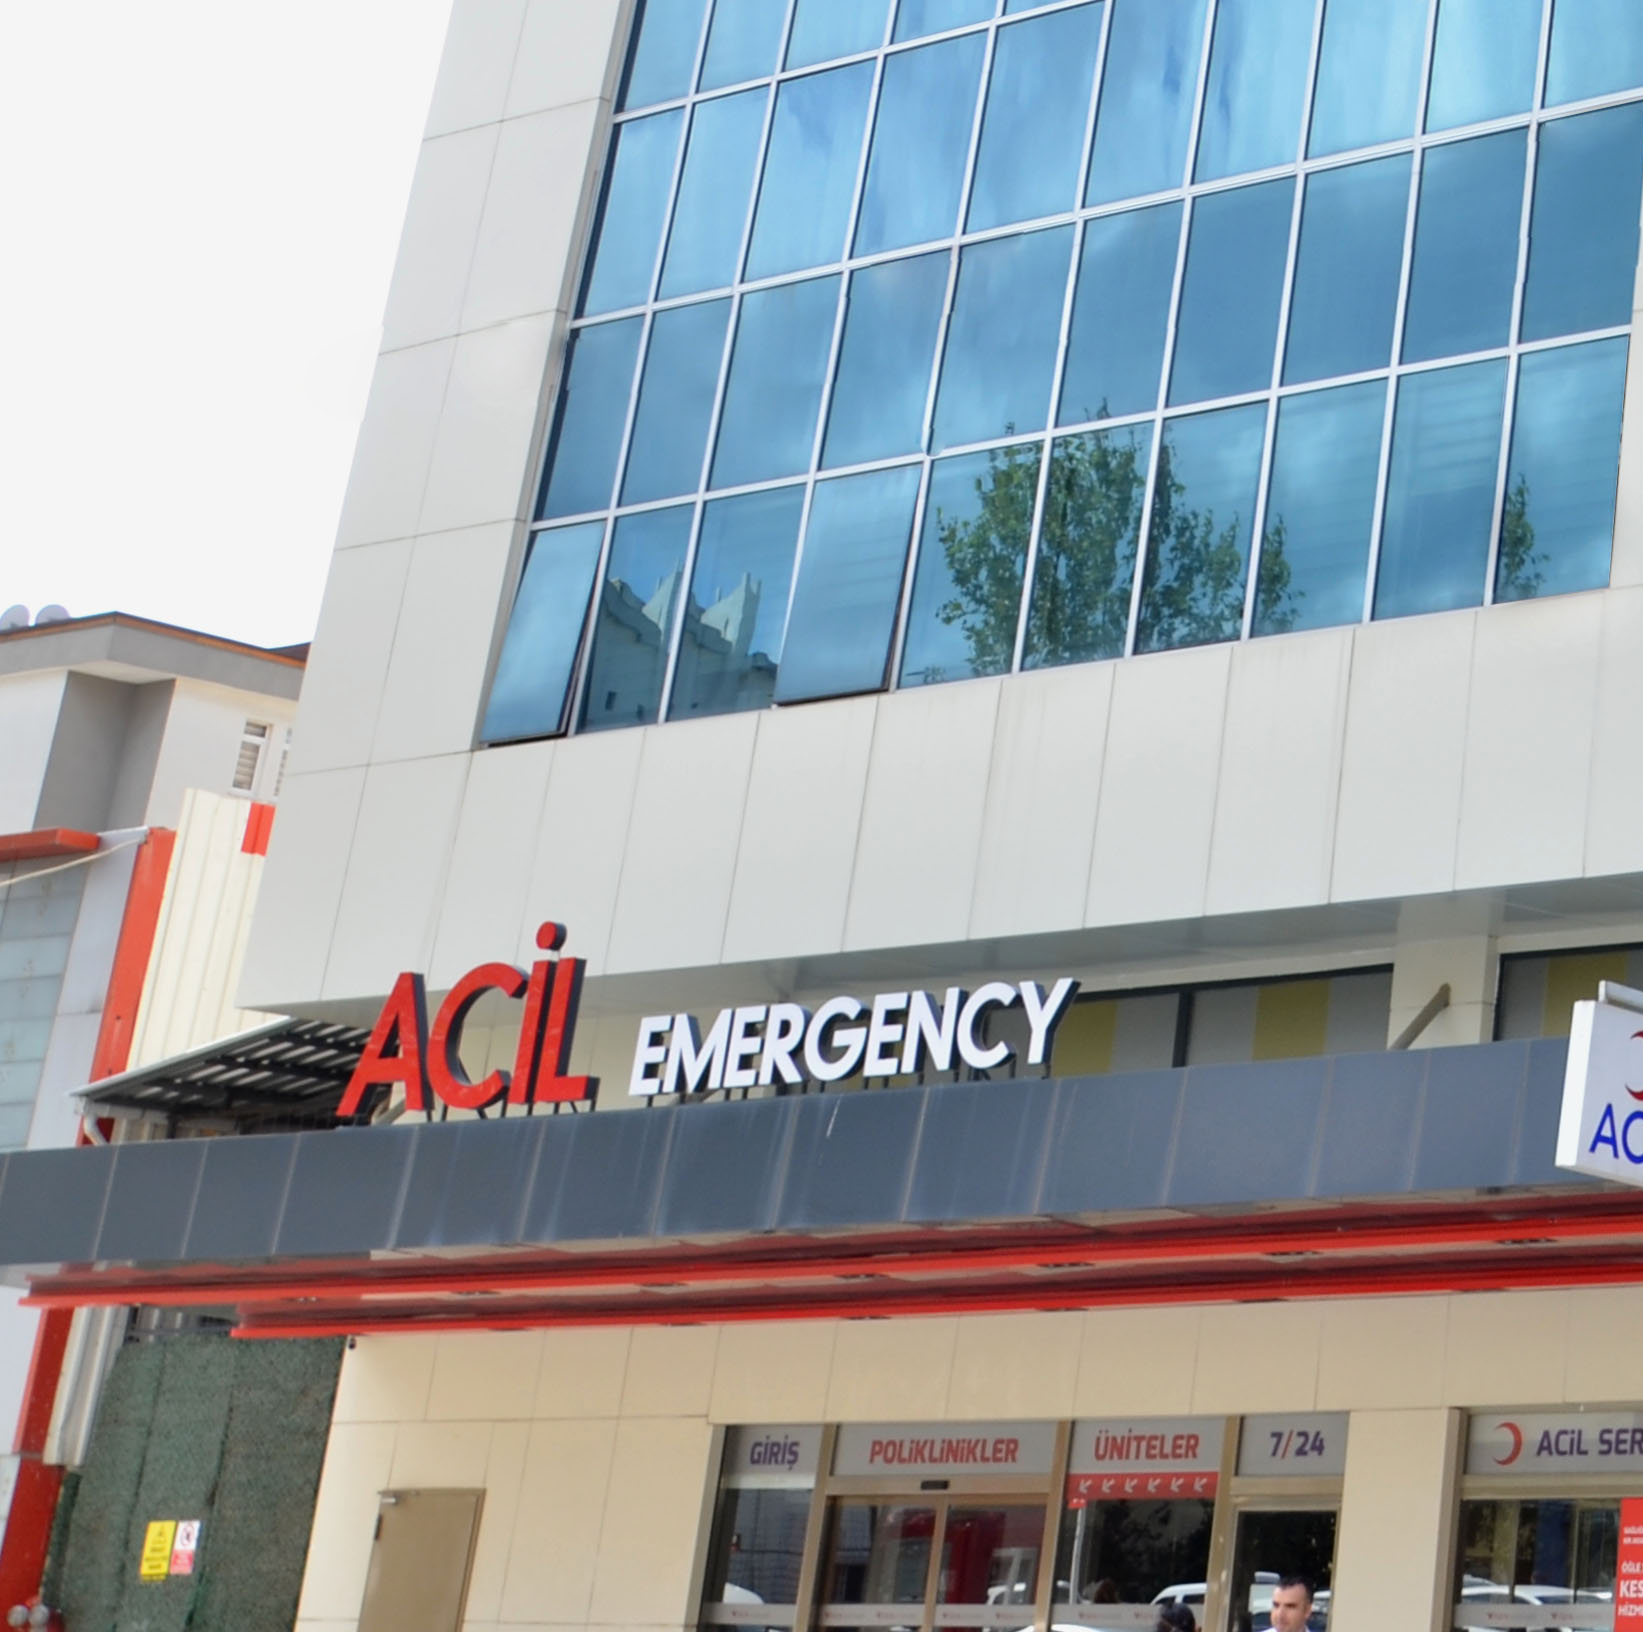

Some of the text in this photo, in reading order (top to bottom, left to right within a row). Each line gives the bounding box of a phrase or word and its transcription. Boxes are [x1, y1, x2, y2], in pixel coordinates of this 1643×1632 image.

[628, 977, 1082, 1096] EMERGENCY
[750, 1435, 801, 1470] GİRİŞ
[1094, 1428, 1200, 1461] ÜNİTELER
[1269, 1430, 1325, 1459] 7/24
